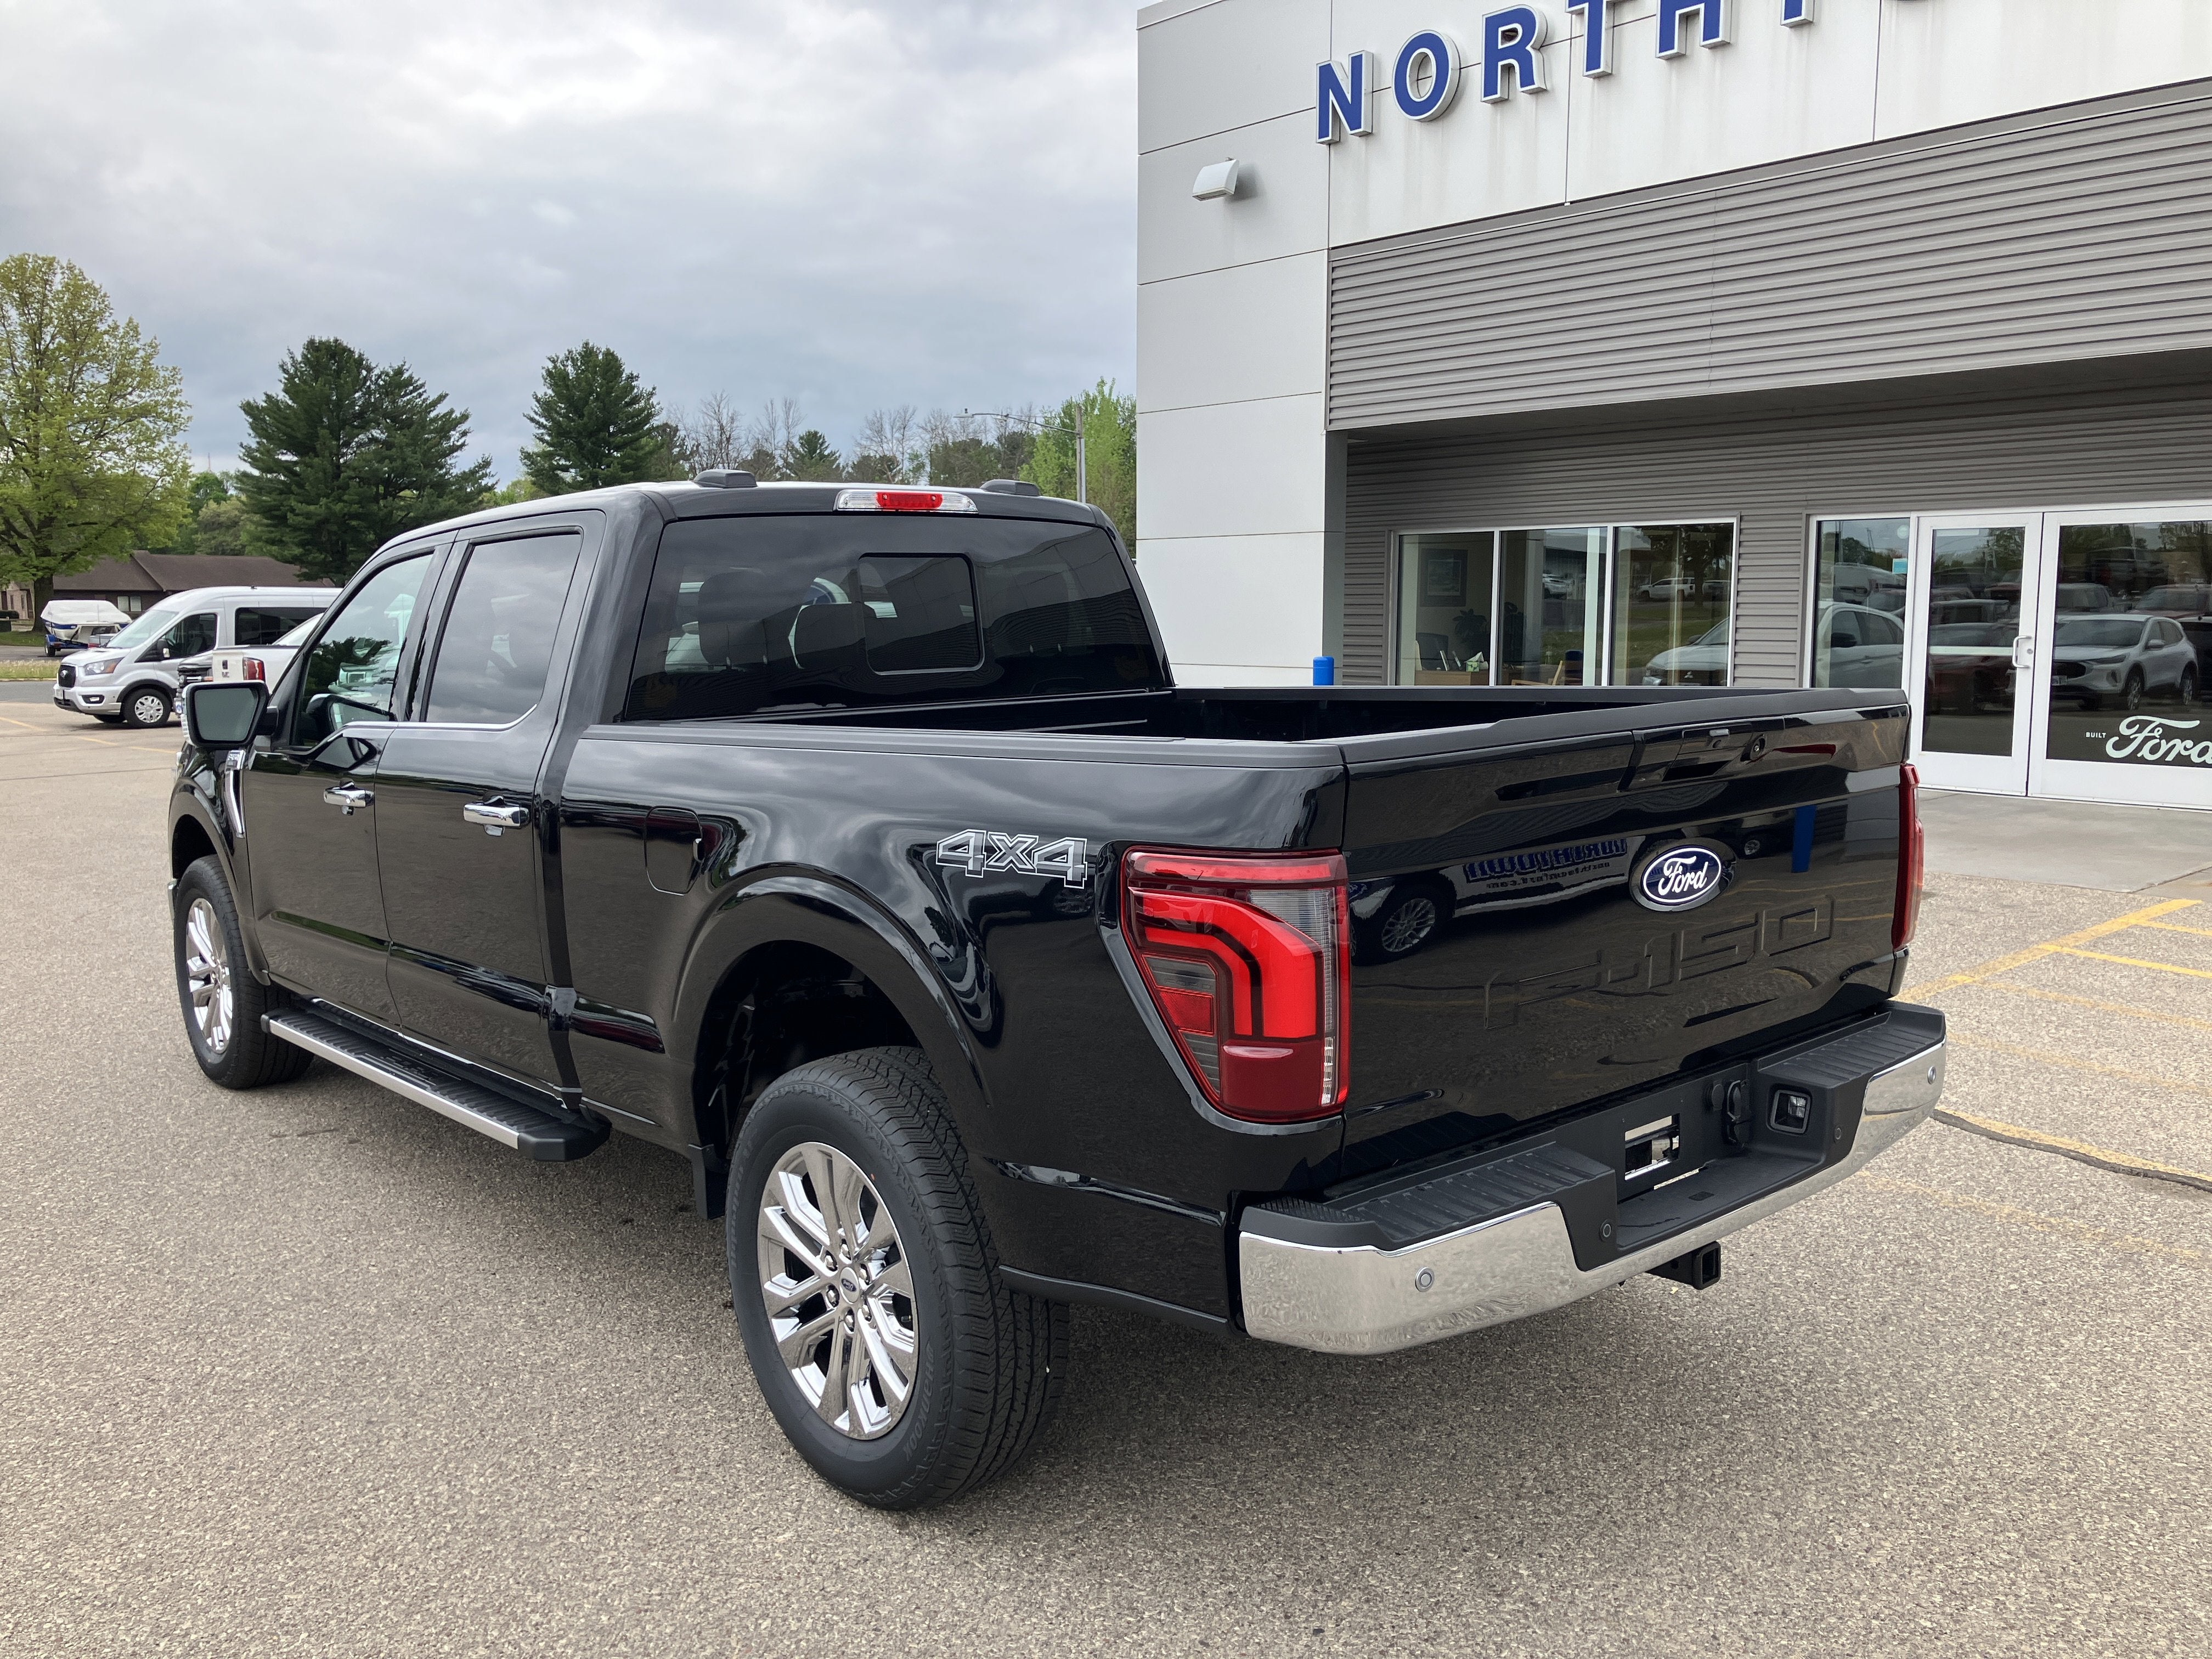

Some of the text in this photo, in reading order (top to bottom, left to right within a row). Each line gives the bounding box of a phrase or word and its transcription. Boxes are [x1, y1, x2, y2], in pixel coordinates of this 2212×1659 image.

[1316, 0, 1814, 144] NORTH
[1657, 855, 1709, 896] Ford
[1483, 894, 1835, 1030] F-150
